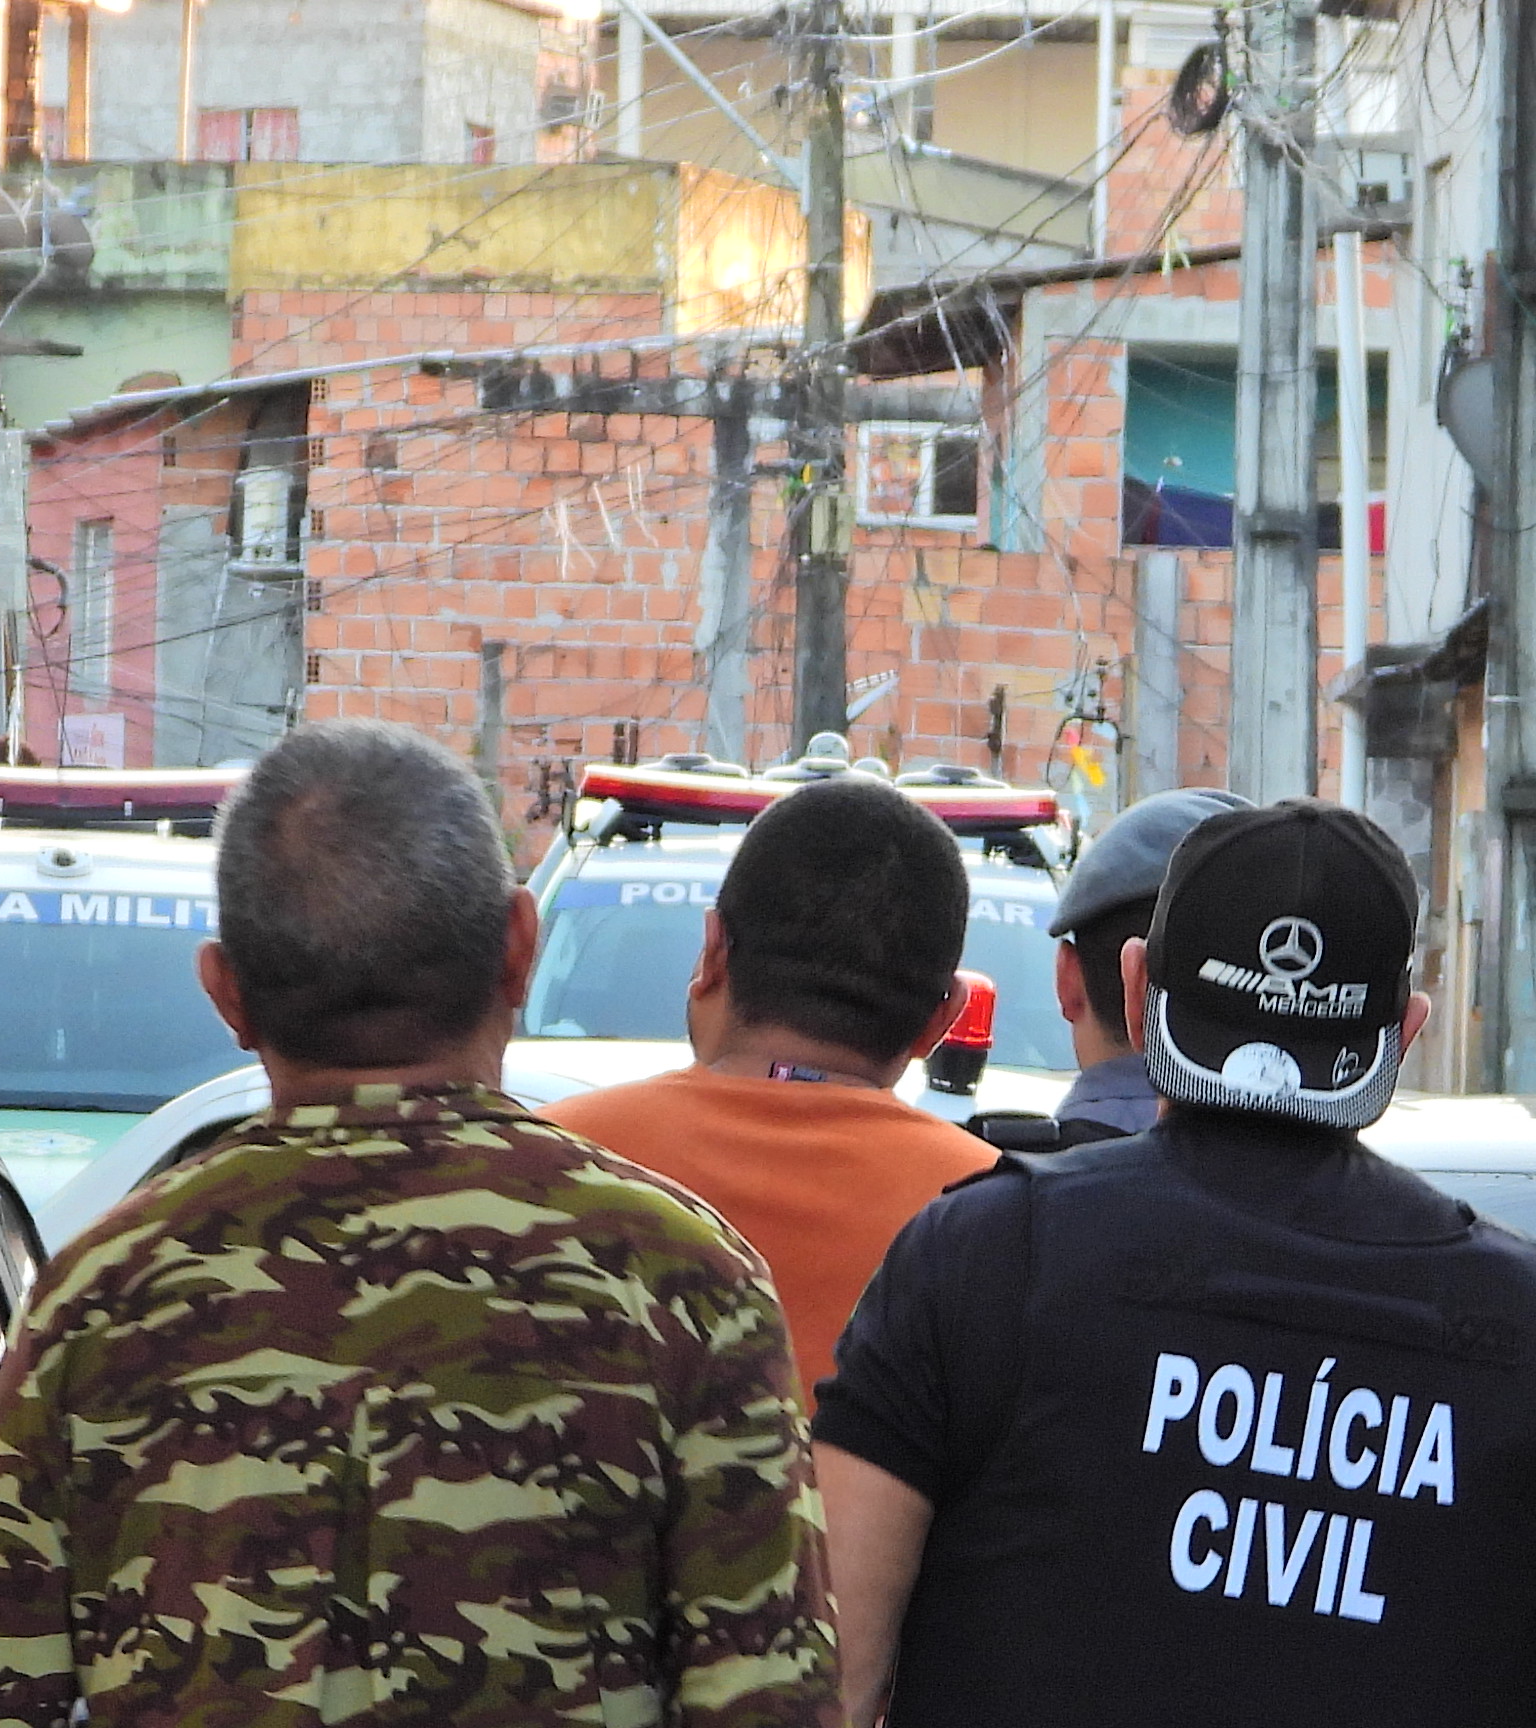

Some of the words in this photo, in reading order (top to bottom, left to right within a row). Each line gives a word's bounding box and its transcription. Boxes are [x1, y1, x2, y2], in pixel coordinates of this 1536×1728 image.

[60, 893, 219, 928] MILIT
[1142, 1352, 1455, 1506] POLÍCIA
[1169, 1489, 1386, 1624] CIVIL
